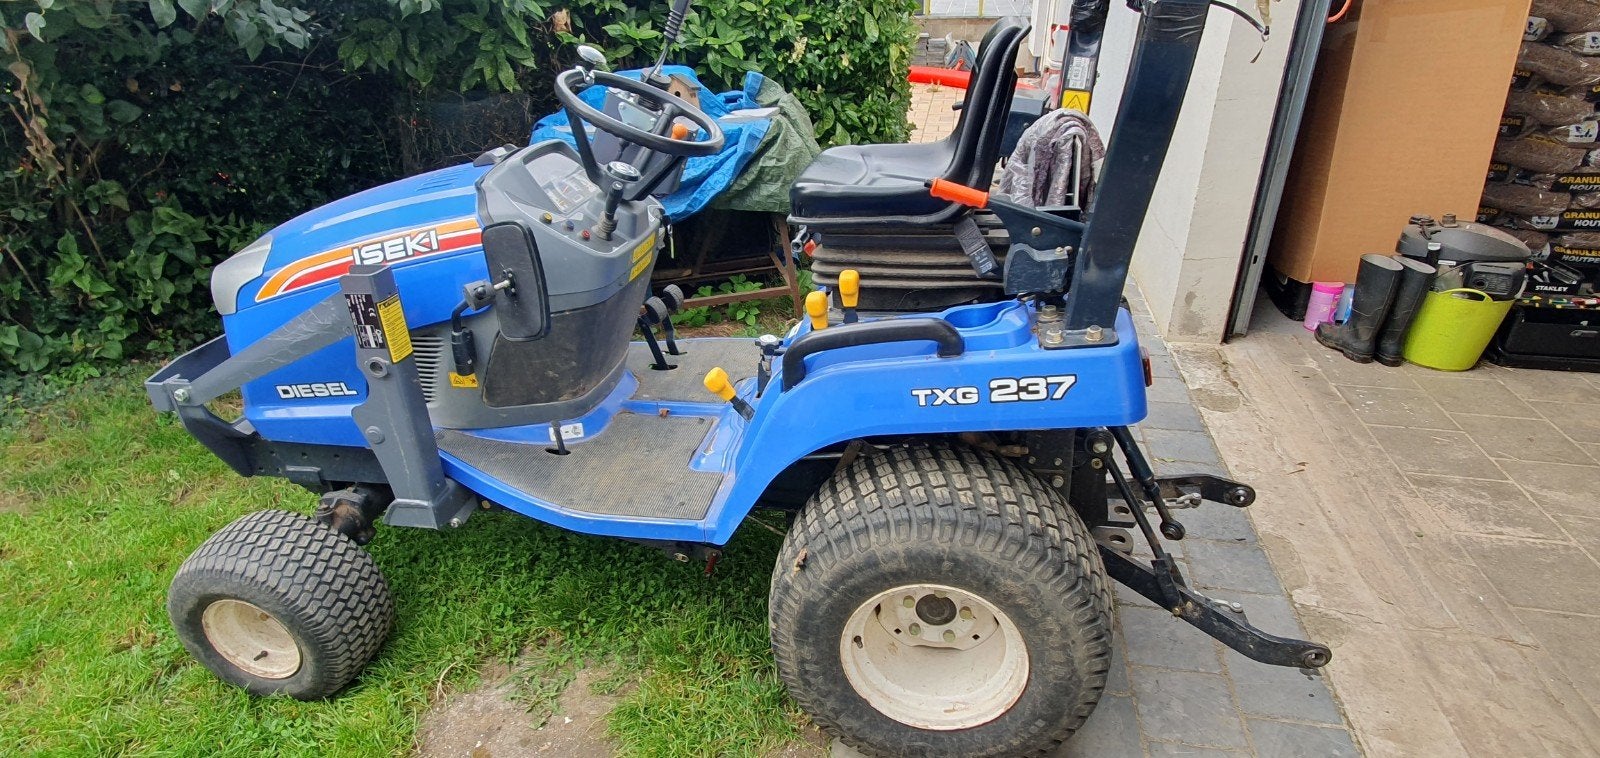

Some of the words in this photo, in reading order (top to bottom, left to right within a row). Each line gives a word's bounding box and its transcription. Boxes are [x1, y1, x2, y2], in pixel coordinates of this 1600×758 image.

[352, 229, 439, 266] ISEKI
[275, 381, 359, 400] DIESEL
[911, 387, 980, 406] TXG
[989, 374, 1077, 403] 237
